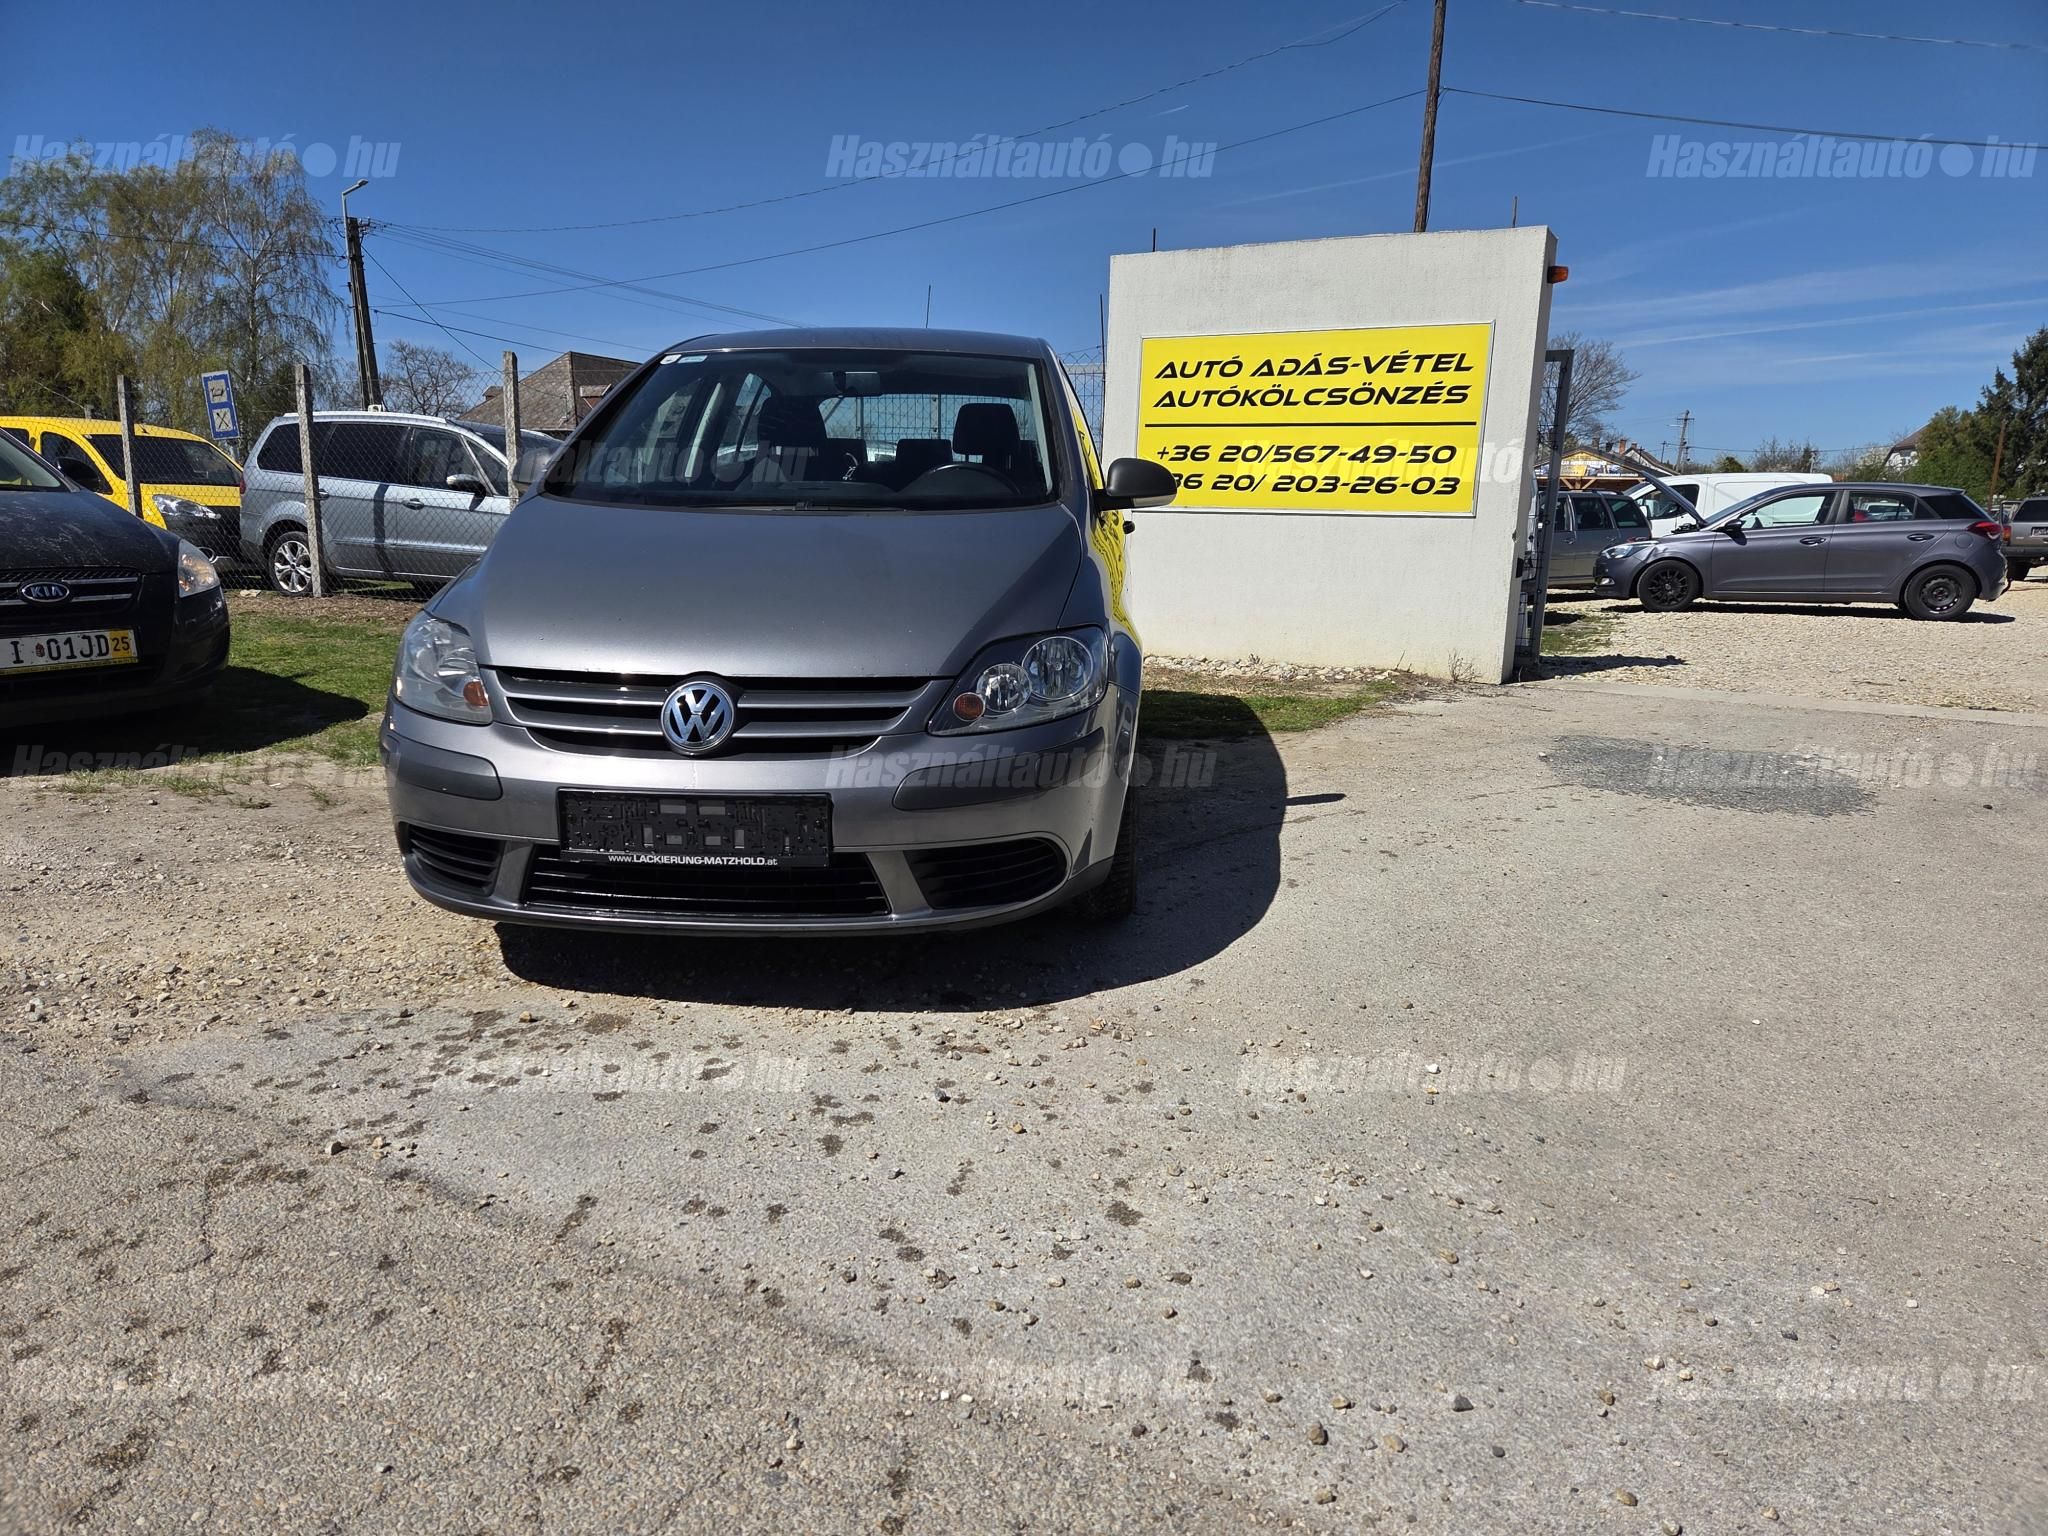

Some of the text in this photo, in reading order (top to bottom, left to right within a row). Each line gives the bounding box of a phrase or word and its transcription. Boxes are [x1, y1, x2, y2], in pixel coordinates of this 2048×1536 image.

[1154, 350, 1475, 379] AUTÓ ADÁS-VÉTEL
[1152, 383, 1473, 408] AUTÓKÖLCSÖNZÉS
[1156, 444, 1458, 464] +36 20/567-49-50
[1211, 474, 1267, 492] 20/
[1272, 475, 1460, 495] 203-26-03
[30, 585, 63, 597] KIA
[112, 637, 131, 652] 25
[666, 684, 729, 746] VW
[608, 854, 778, 867] www.LACKIERUNG-MATZHOLD.at
